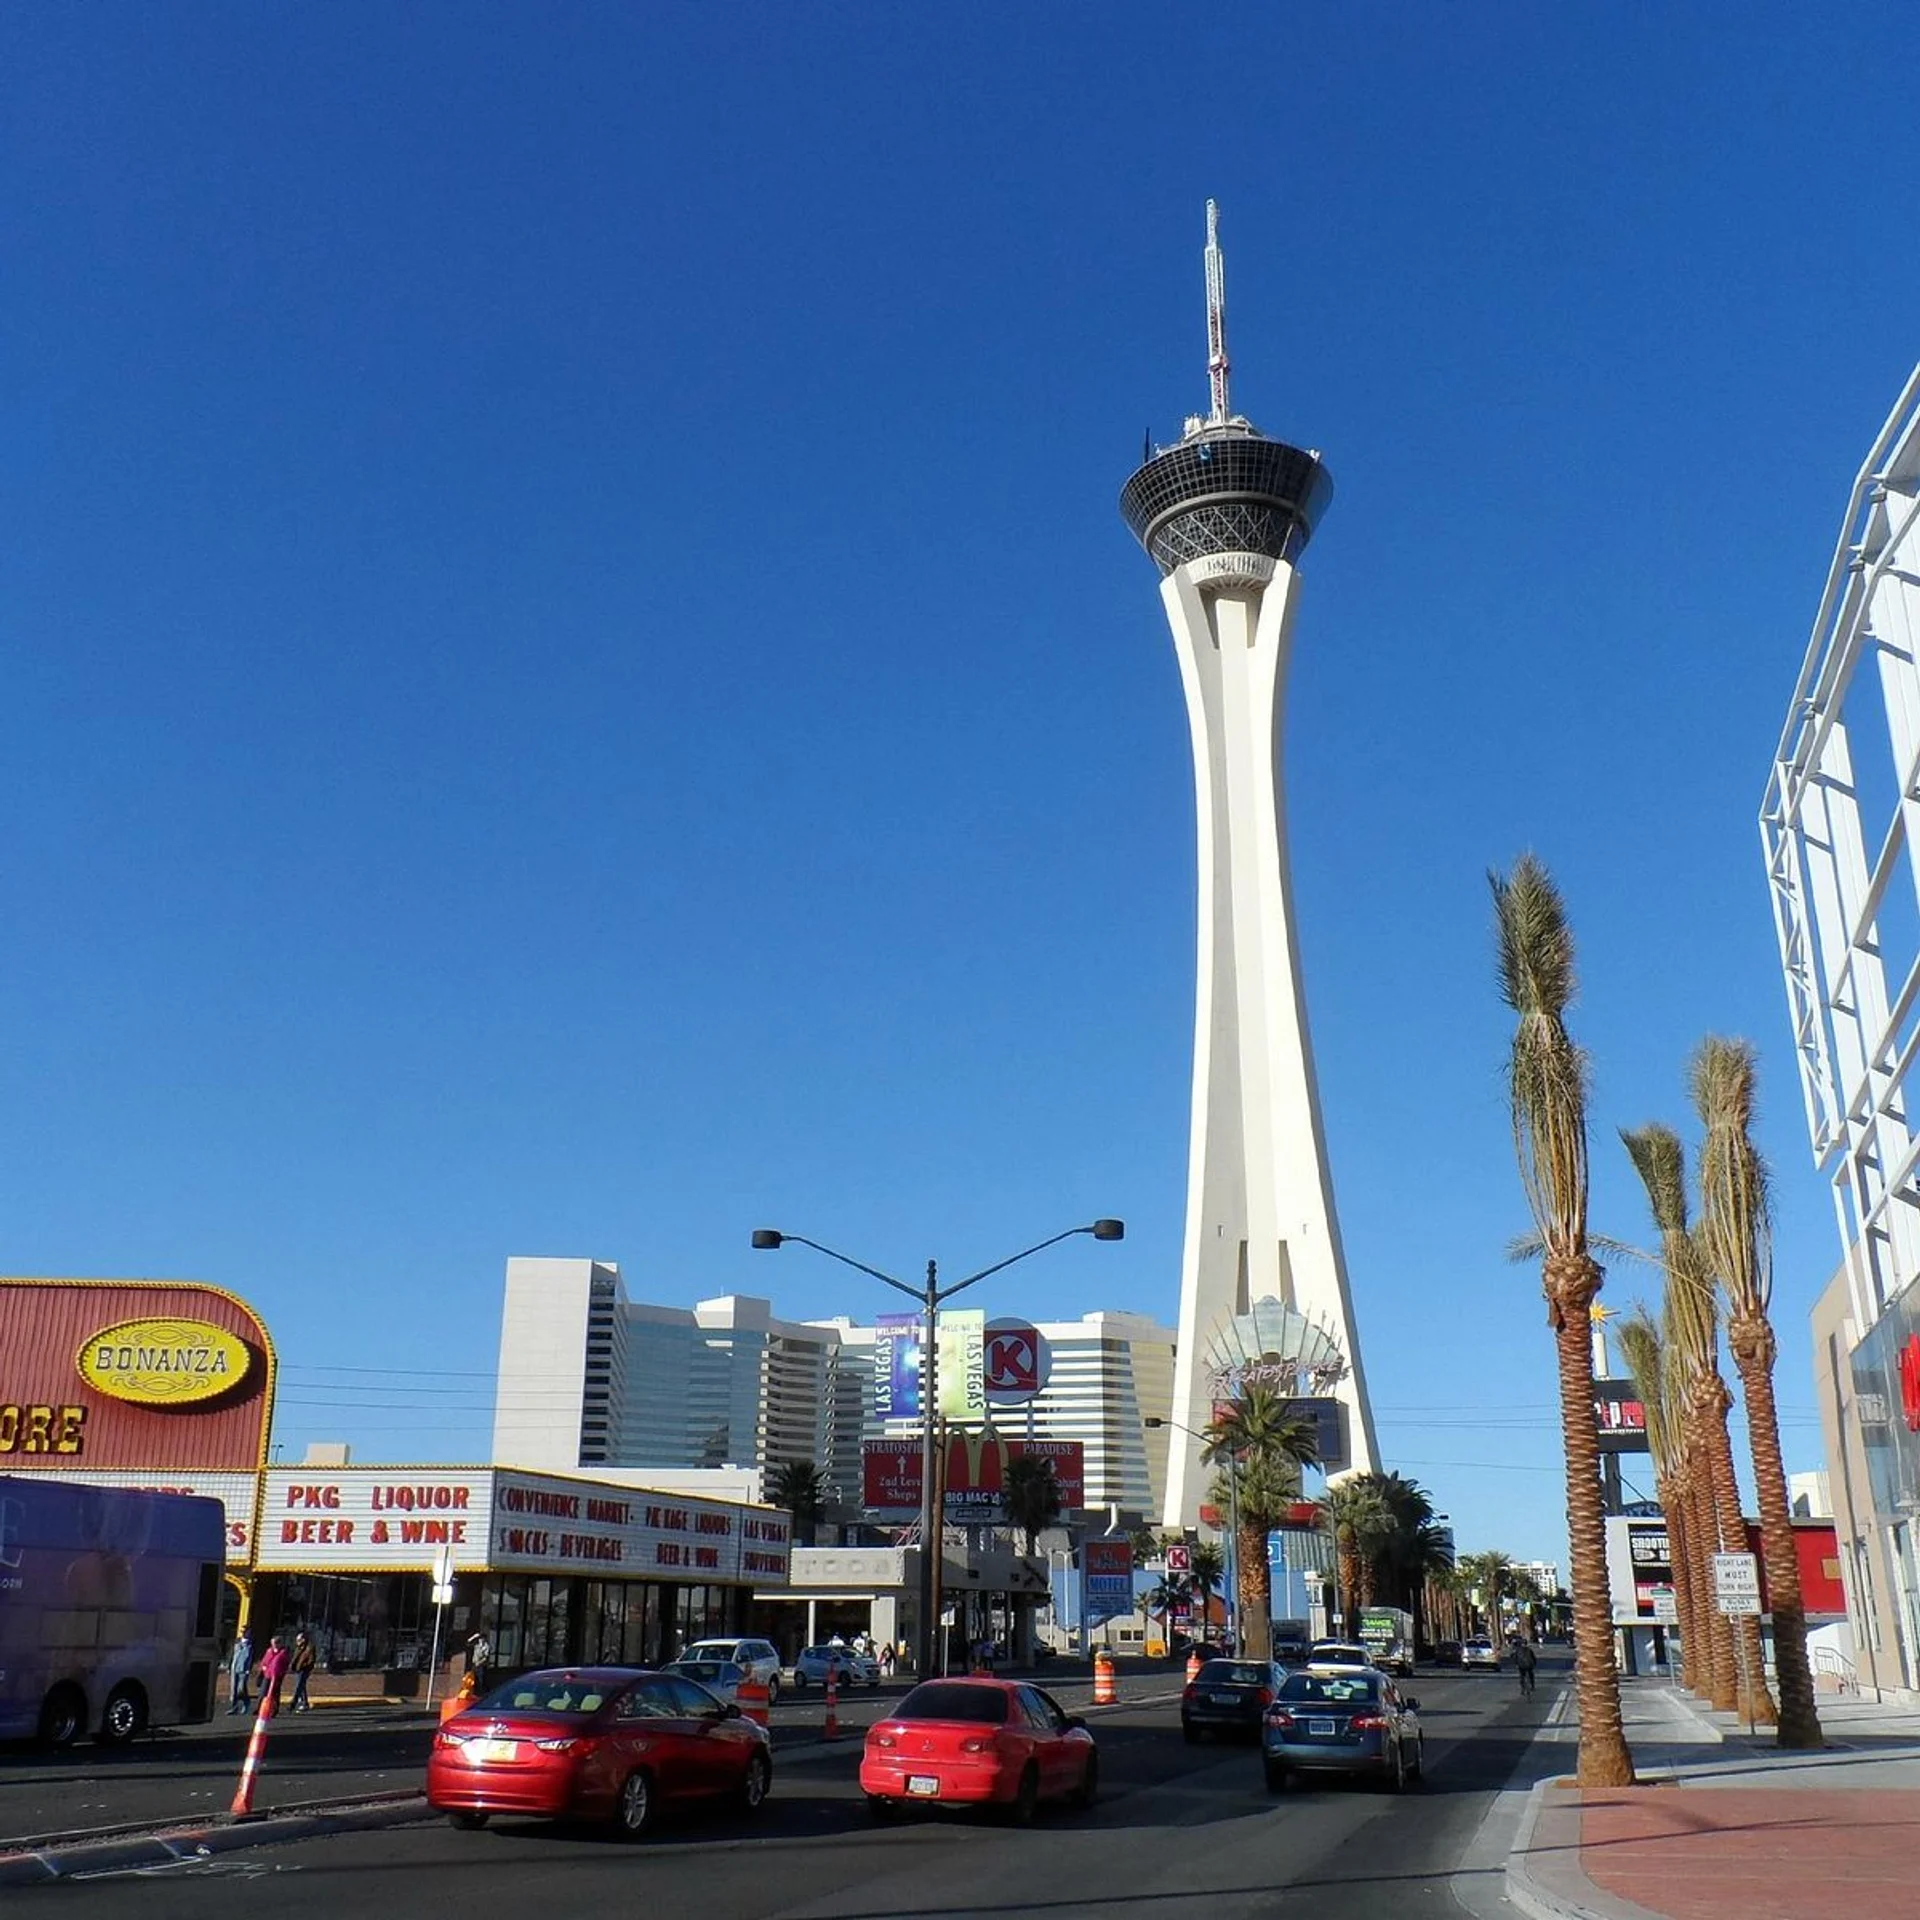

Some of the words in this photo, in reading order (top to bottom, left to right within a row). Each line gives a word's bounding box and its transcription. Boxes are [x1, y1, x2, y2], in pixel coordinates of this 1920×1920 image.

[96, 1346, 228, 1373] BONANZA
[967, 1334, 983, 1361] LAS
[875, 1337, 892, 1385] VEGAS
[991, 1340, 1032, 1381] K
[875, 1386, 892, 1412] LAS
[967, 1363, 983, 1410] VEGAS
[1023, 1443, 1074, 1456] PARADISE
[287, 1486, 340, 1509] PKG
[371, 1486, 469, 1511] LIQUOR
[500, 1486, 580, 1519] CONVENIENCE
[945, 1492, 964, 1503] BIG
[966, 1492, 988, 1503] MAC
[281, 1520, 353, 1543] BEER
[370, 1520, 389, 1543] &
[402, 1520, 467, 1544] WINE
[1725, 1571, 1747, 1579] MUST
[1736, 1559, 1752, 1567] LANE
[1089, 1577, 1124, 1592] MOTEL
